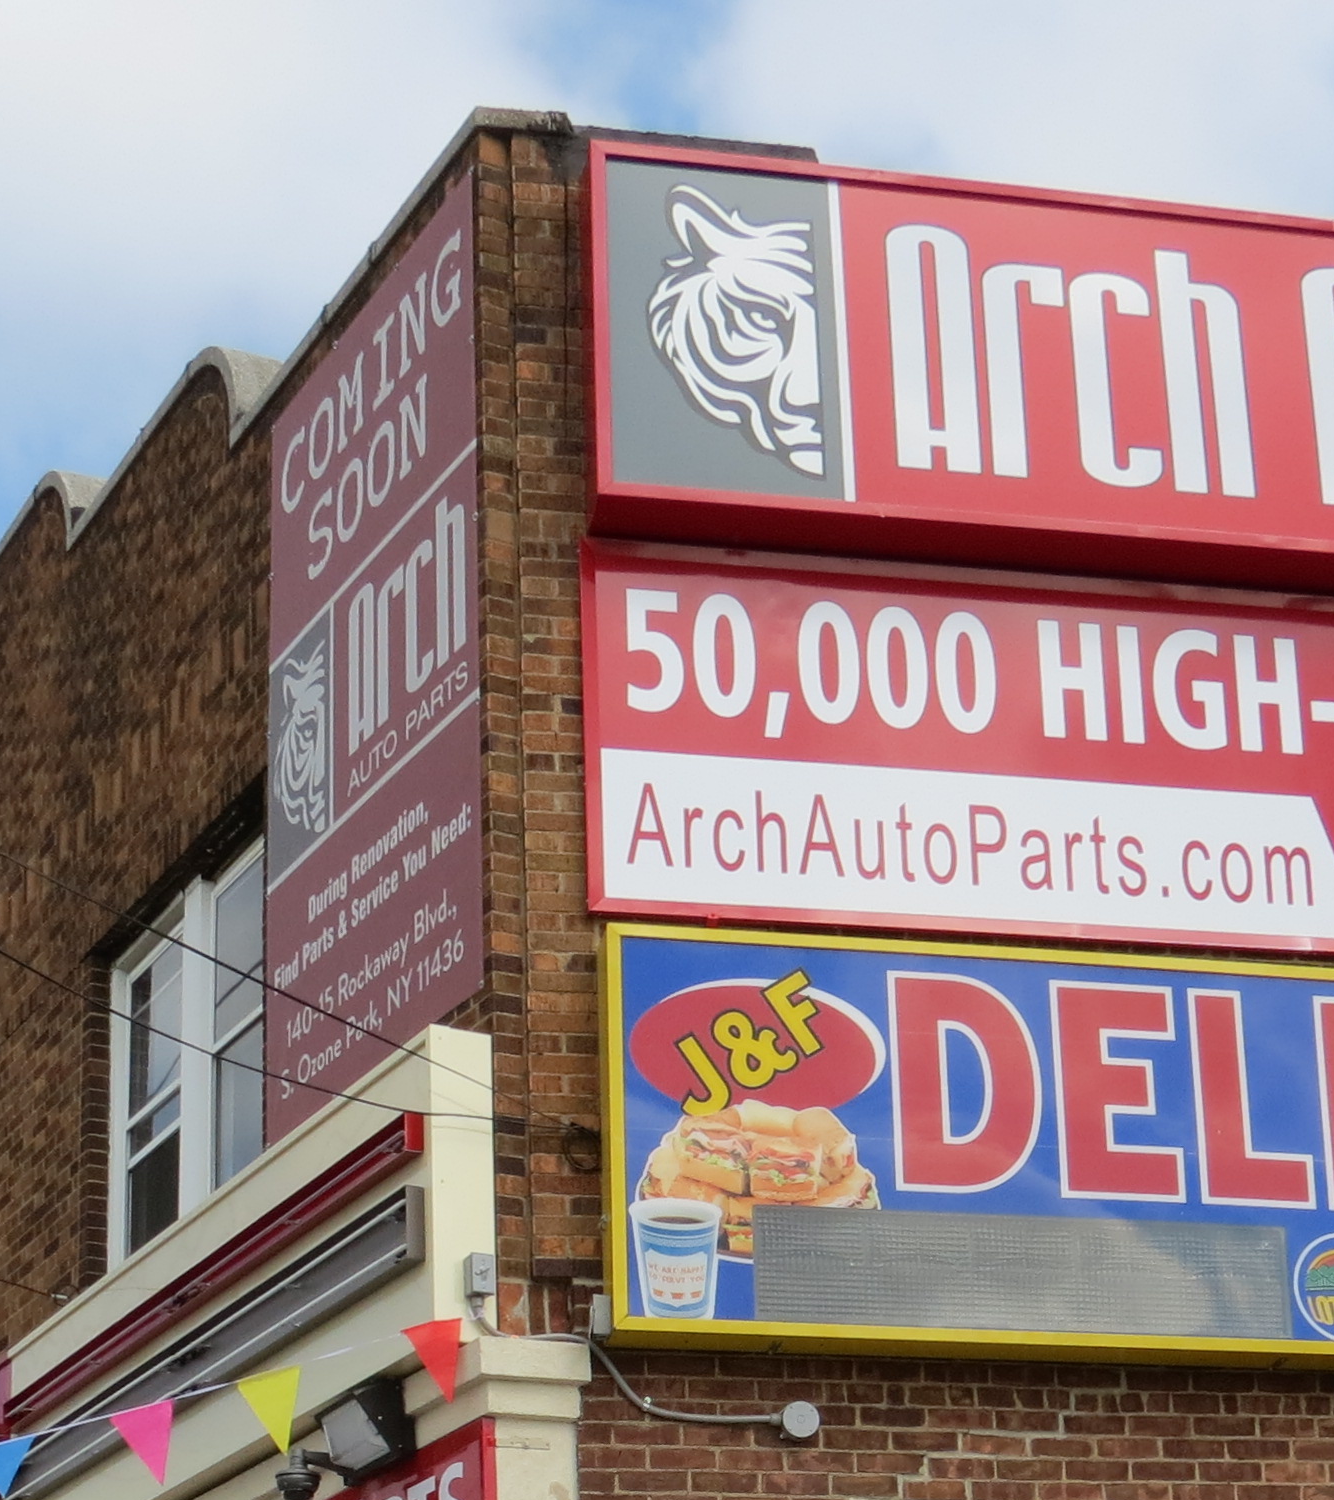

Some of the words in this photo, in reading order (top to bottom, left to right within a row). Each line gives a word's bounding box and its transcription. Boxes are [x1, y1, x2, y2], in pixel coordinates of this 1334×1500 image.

[280, 228, 463, 514] COMING
[884, 223, 1258, 499] Arch
[307, 372, 429, 582] SOON
[348, 495, 467, 757] Arch
[624, 587, 998, 739] 50,000
[347, 728, 398, 798] AUTO
[405, 660, 469, 741] PARTS
[273, 951, 300, 996] Find
[302, 926, 335, 972] Parts
[337, 909, 348, 940] &
[350, 869, 399, 928] Service
[401, 844, 427, 883] You
[430, 802, 472, 860] Need:
[307, 870, 348, 925] During
[350, 801, 430, 885] Renovation,
[626, 780, 1315, 907] ArchAutoParts.com
[280, 1067, 295, 1101] S.
[297, 1037, 342, 1085] Ozone
[345, 1000, 384, 1050] Park,
[386, 967, 413, 1017] NY
[415, 928, 465, 992] 11436
[285, 985, 335, 1049] 140-15
[337, 932, 410, 1007] Rockaway
[680, 966, 822, 1118] J&F
